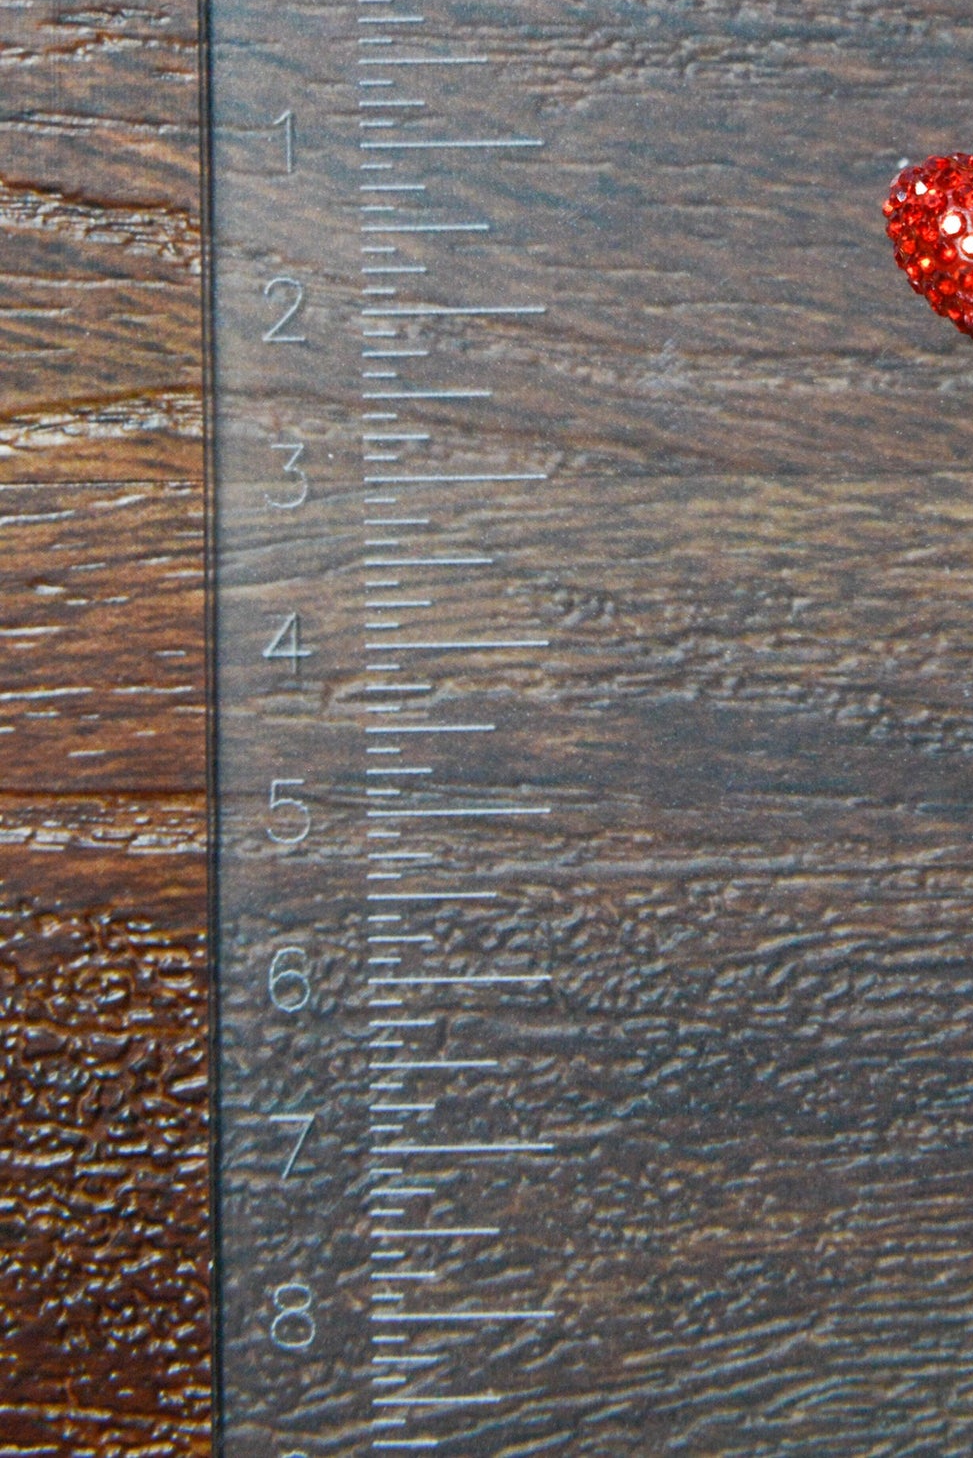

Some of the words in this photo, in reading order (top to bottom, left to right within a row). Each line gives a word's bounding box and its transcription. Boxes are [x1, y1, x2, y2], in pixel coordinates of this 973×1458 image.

[272, 109, 294, 174] 1
[262, 276, 306, 342] 2
[263, 442, 308, 509] 3
[262, 611, 312, 674] 4
[266, 778, 311, 843] 5
[268, 946, 311, 1012] 6
[268, 1112, 315, 1179] 7
[270, 1282, 316, 1348] 8
